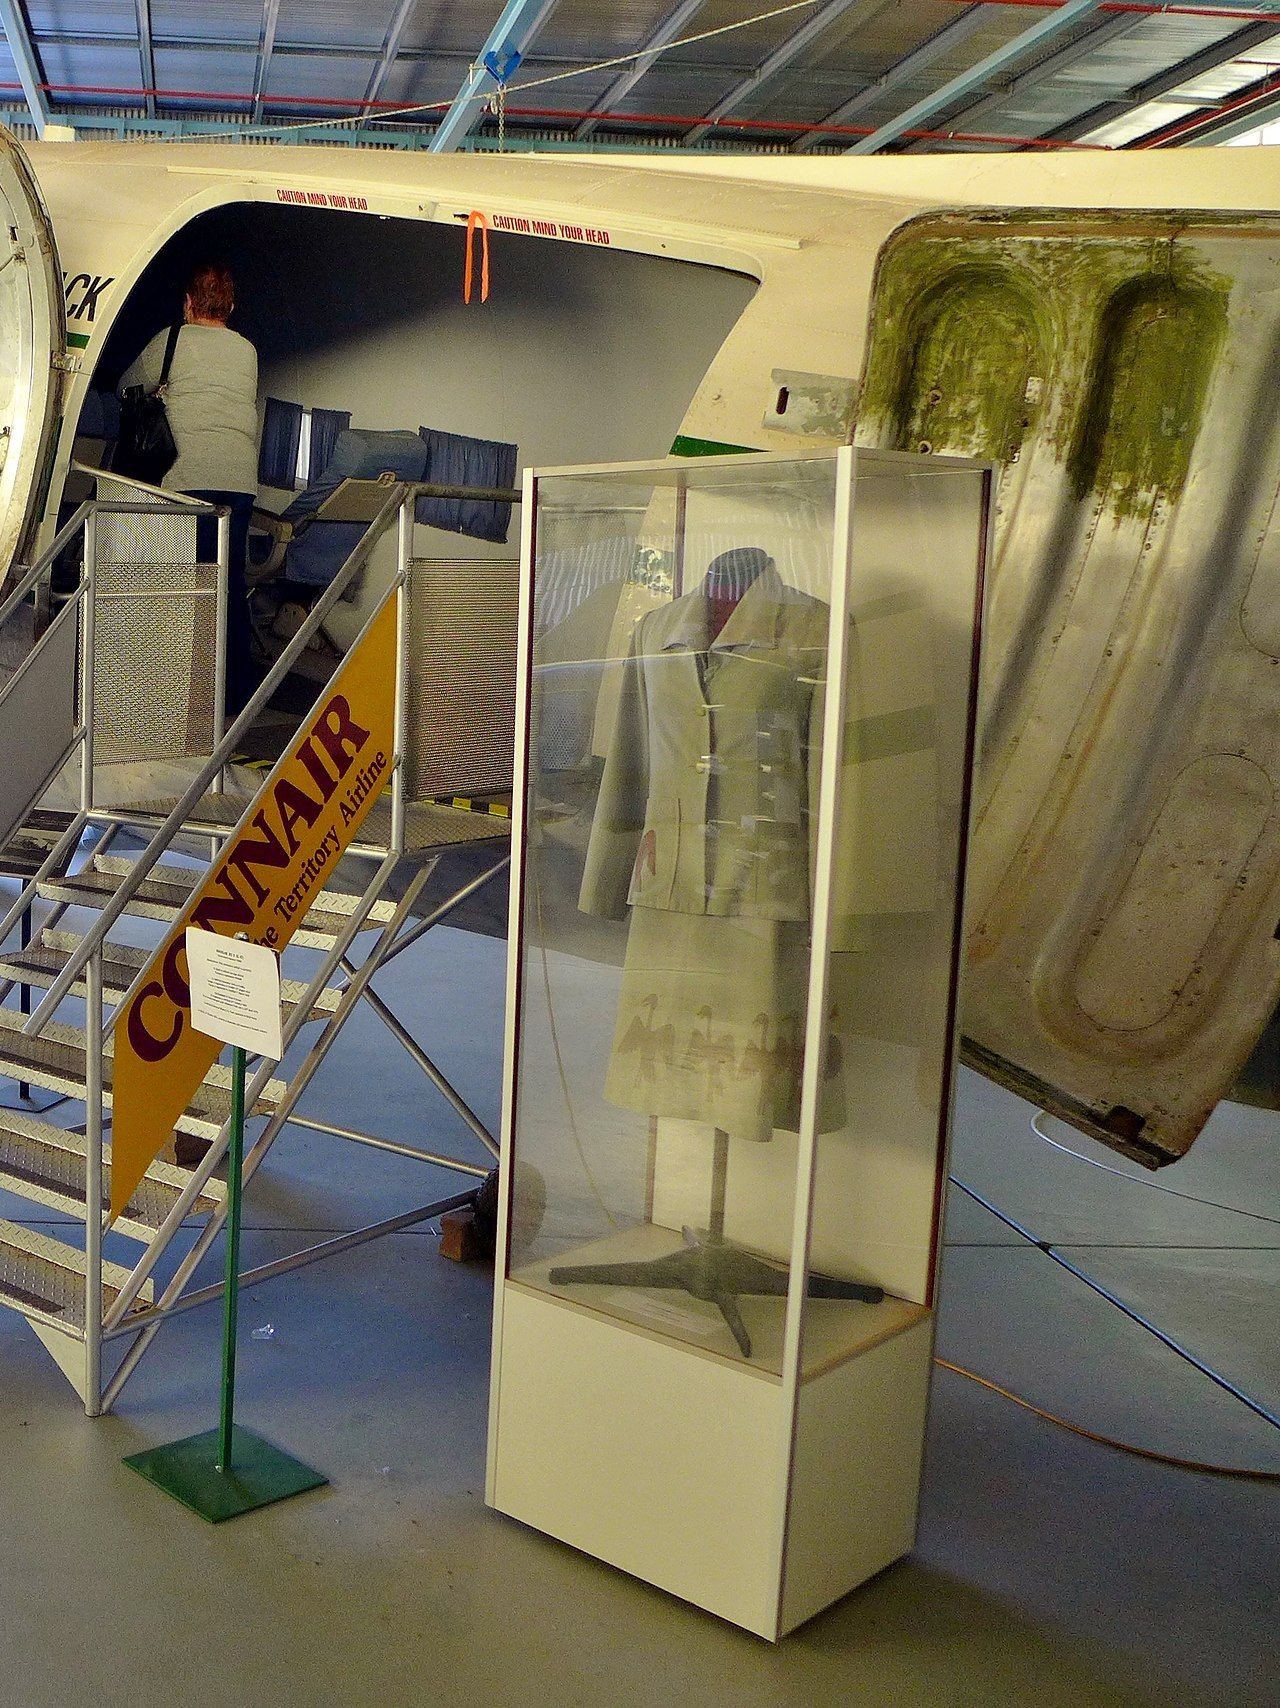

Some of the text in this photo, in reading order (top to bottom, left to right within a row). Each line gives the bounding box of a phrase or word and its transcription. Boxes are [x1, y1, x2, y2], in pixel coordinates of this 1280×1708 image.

[276, 189, 368, 211] CAUTION MIND YOUR HEAD
[492, 214, 611, 245] CAUTION MIND YOUR HEAD
[62, 271, 116, 322] CK
[253, 751, 388, 949] he Territory Airline
